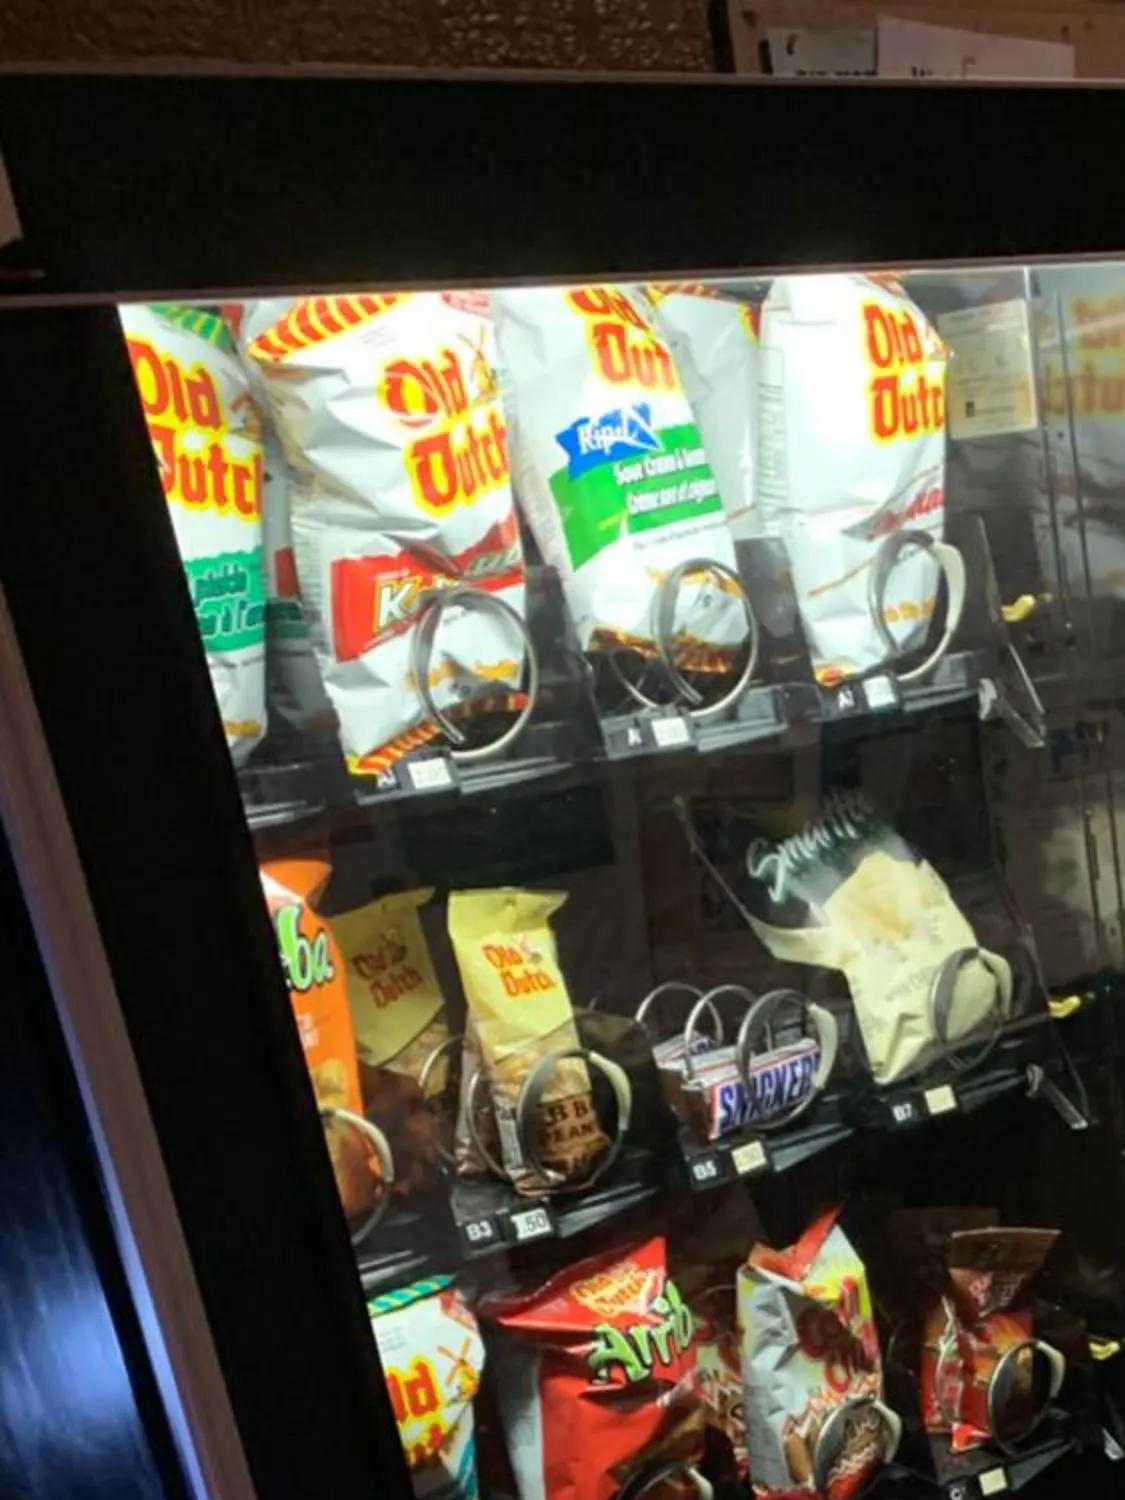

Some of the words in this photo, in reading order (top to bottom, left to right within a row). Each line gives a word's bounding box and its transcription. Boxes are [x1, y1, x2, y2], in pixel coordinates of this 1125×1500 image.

[593, 322, 675, 389] Dut
[864, 304, 923, 368] Old
[128, 340, 222, 430] Old
[385, 349, 469, 428] Old
[871, 376, 945, 438] Dutc
[482, 944, 523, 969] Old
[718, 1054, 820, 1129] SNICKER
[466, 1218, 494, 1242] B3
[384, 1361, 438, 1422] ld
